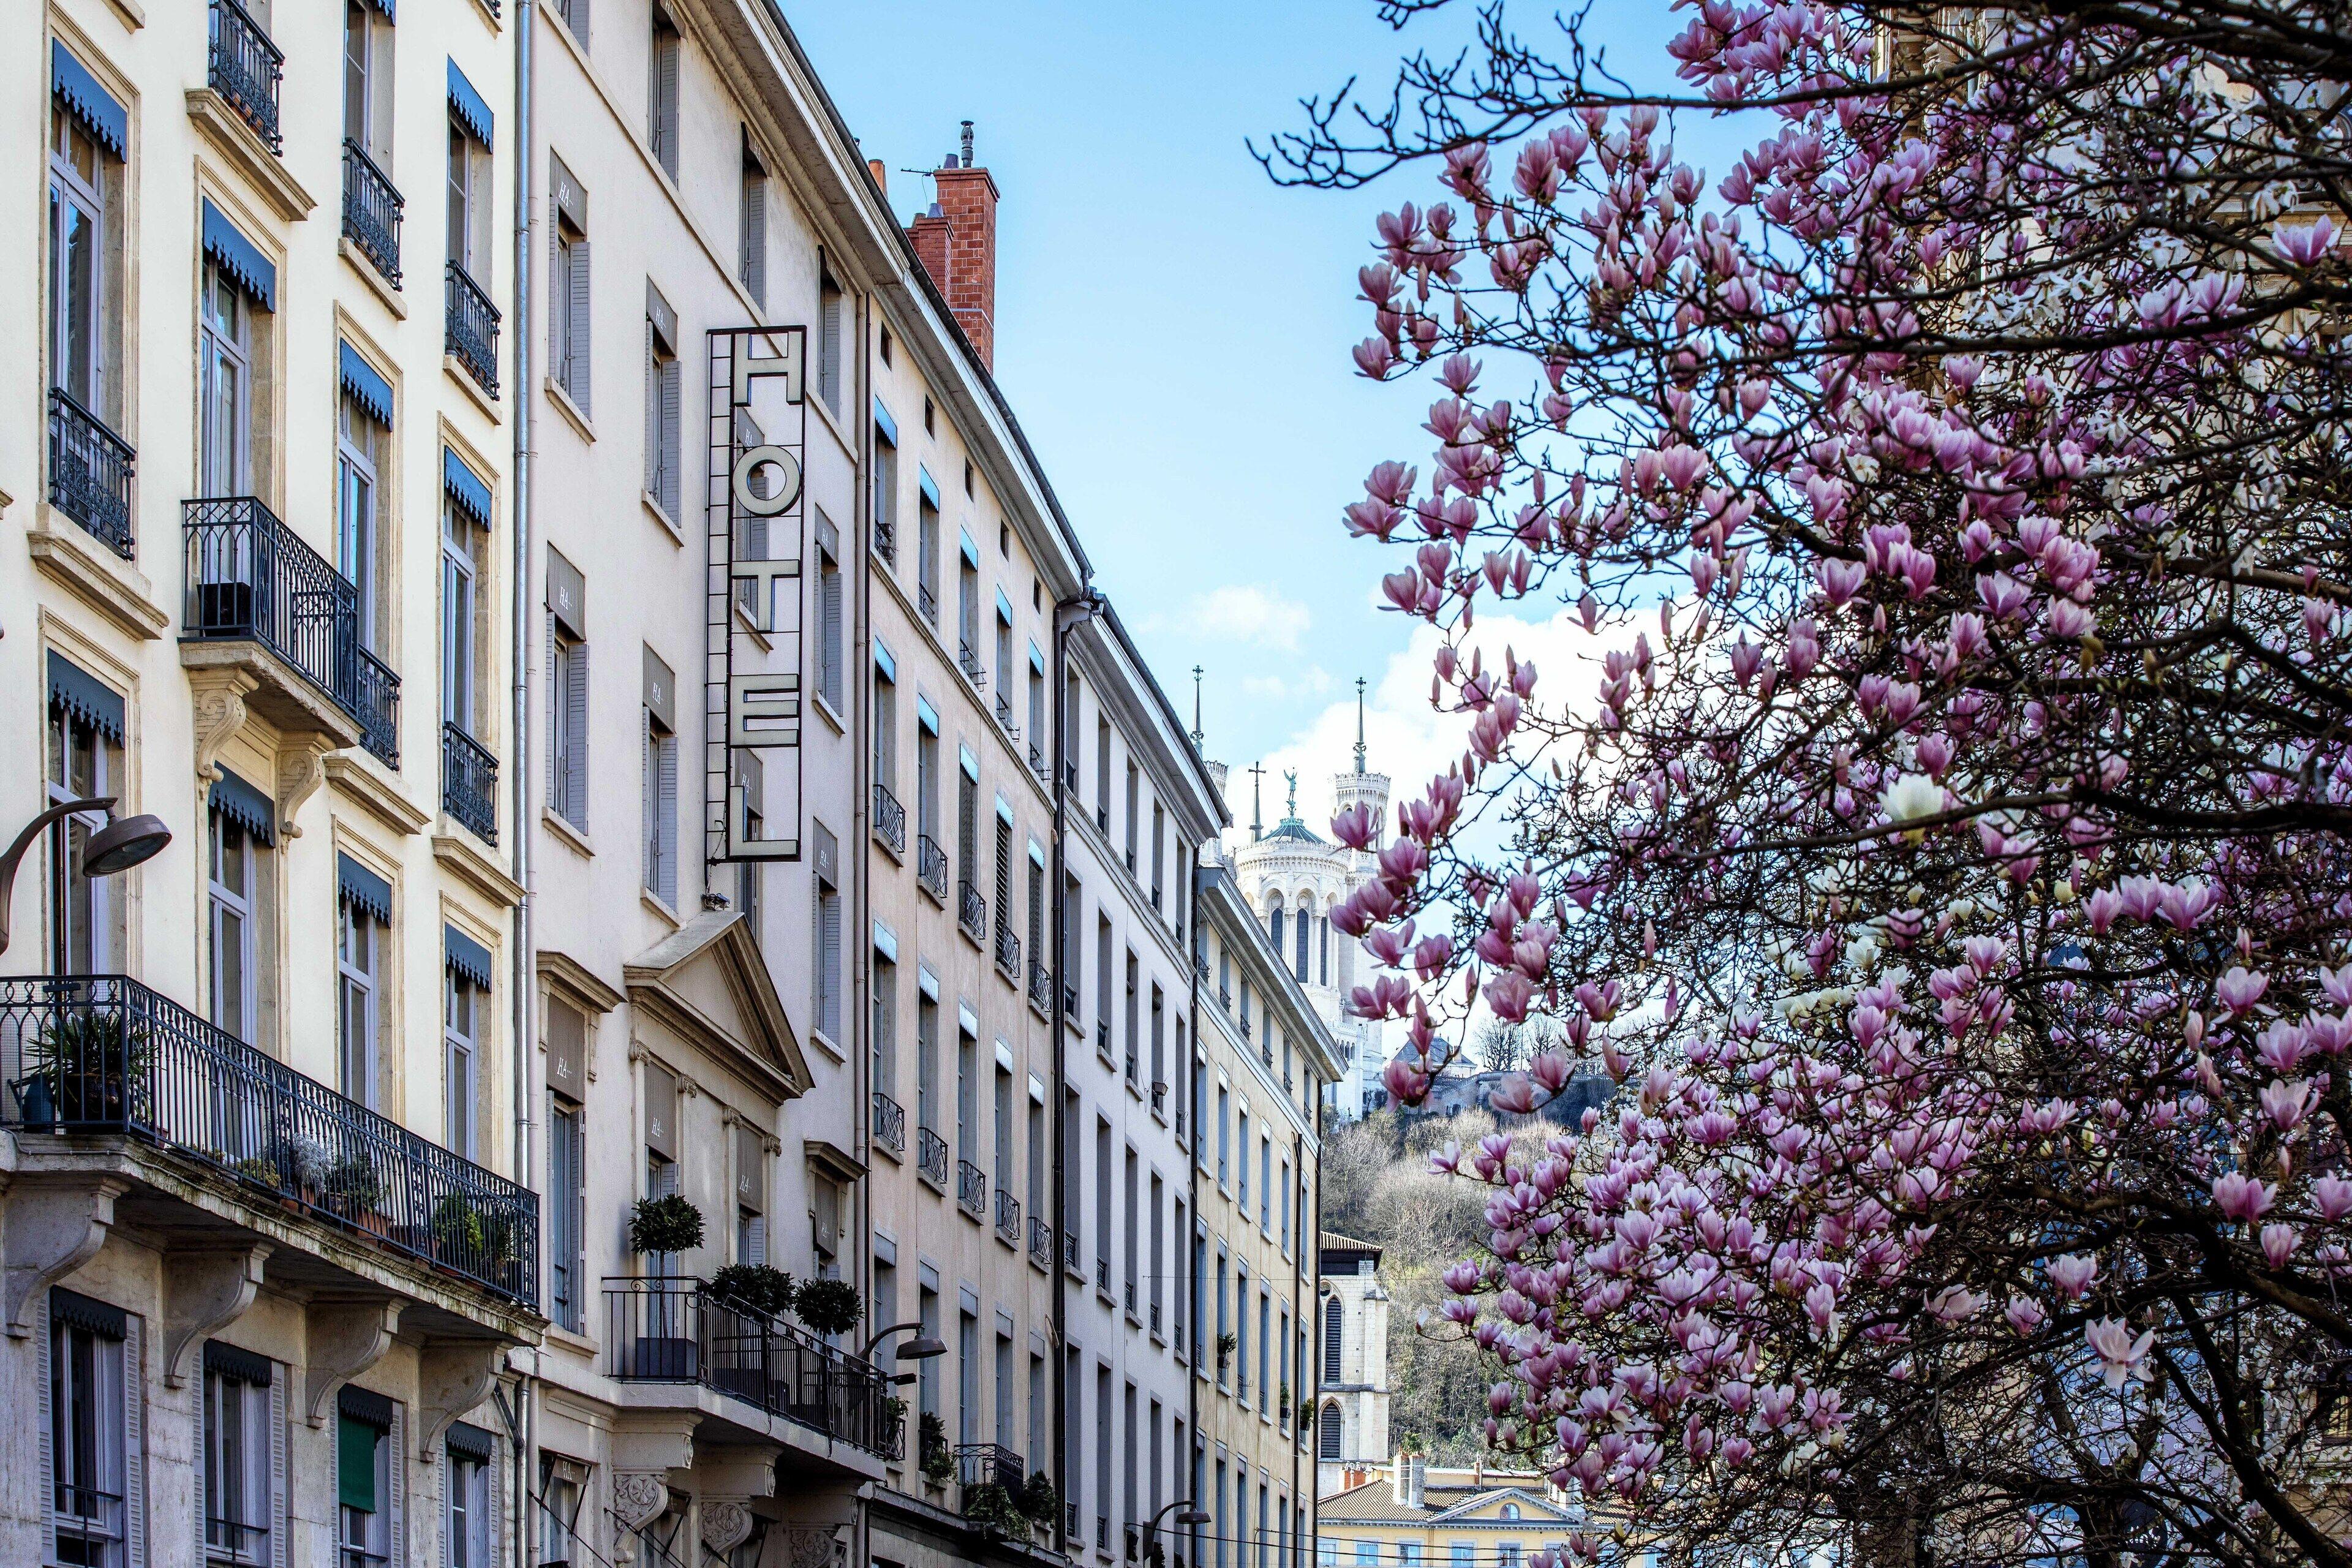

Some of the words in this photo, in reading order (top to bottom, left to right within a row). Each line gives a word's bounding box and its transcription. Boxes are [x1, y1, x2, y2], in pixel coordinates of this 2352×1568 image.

[559, 181, 570, 207] HA
[656, 306, 663, 330] HA
[821, 527, 828, 548] HA
[559, 586, 568, 610] HA
[729, 333, 803, 856] HOTEL
[652, 682, 661, 705] HA
[820, 850, 826, 869] HA
[557, 1057, 567, 1079] HA
[651, 1117, 660, 1138] HA
[739, 1175, 749, 1193] HA
[562, 1461, 573, 1480] HA
